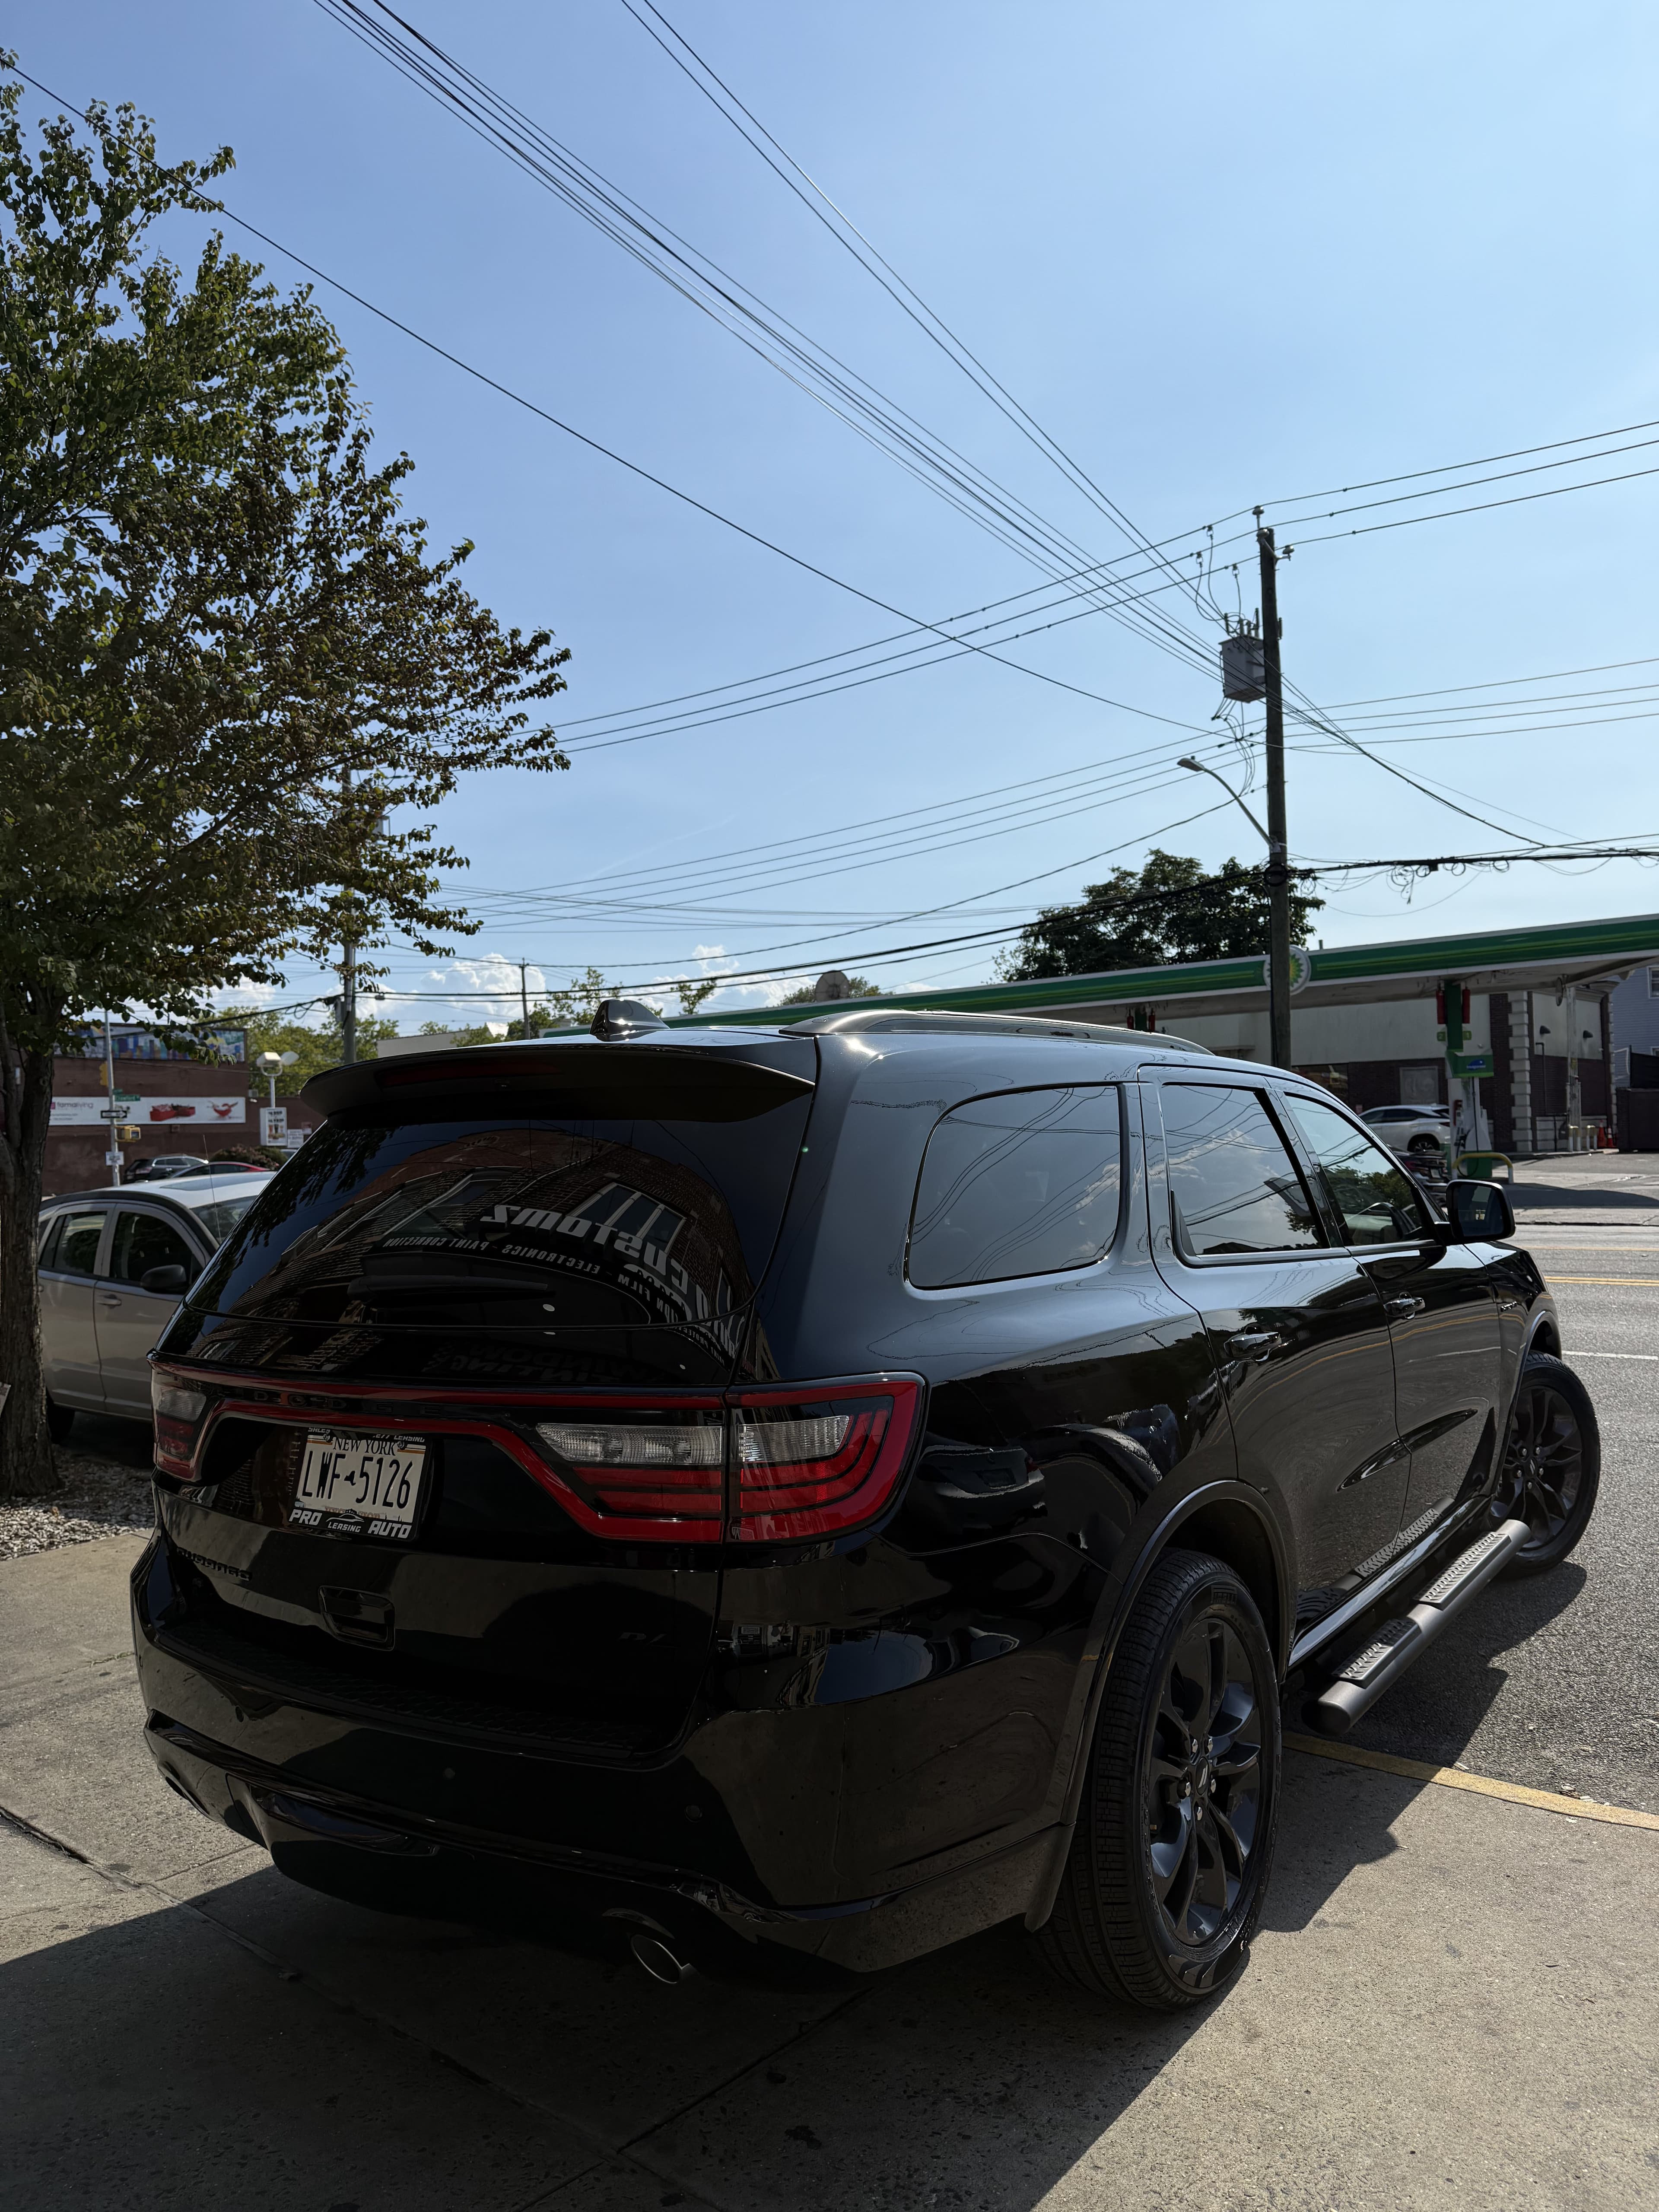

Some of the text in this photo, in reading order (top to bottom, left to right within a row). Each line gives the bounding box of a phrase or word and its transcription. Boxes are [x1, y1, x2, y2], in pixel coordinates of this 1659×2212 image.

[333, 1437, 397, 1456] NEW YORK
[302, 1451, 413, 1509] LWF 5126
[289, 1509, 413, 1539] PRO LEASING AUTO
